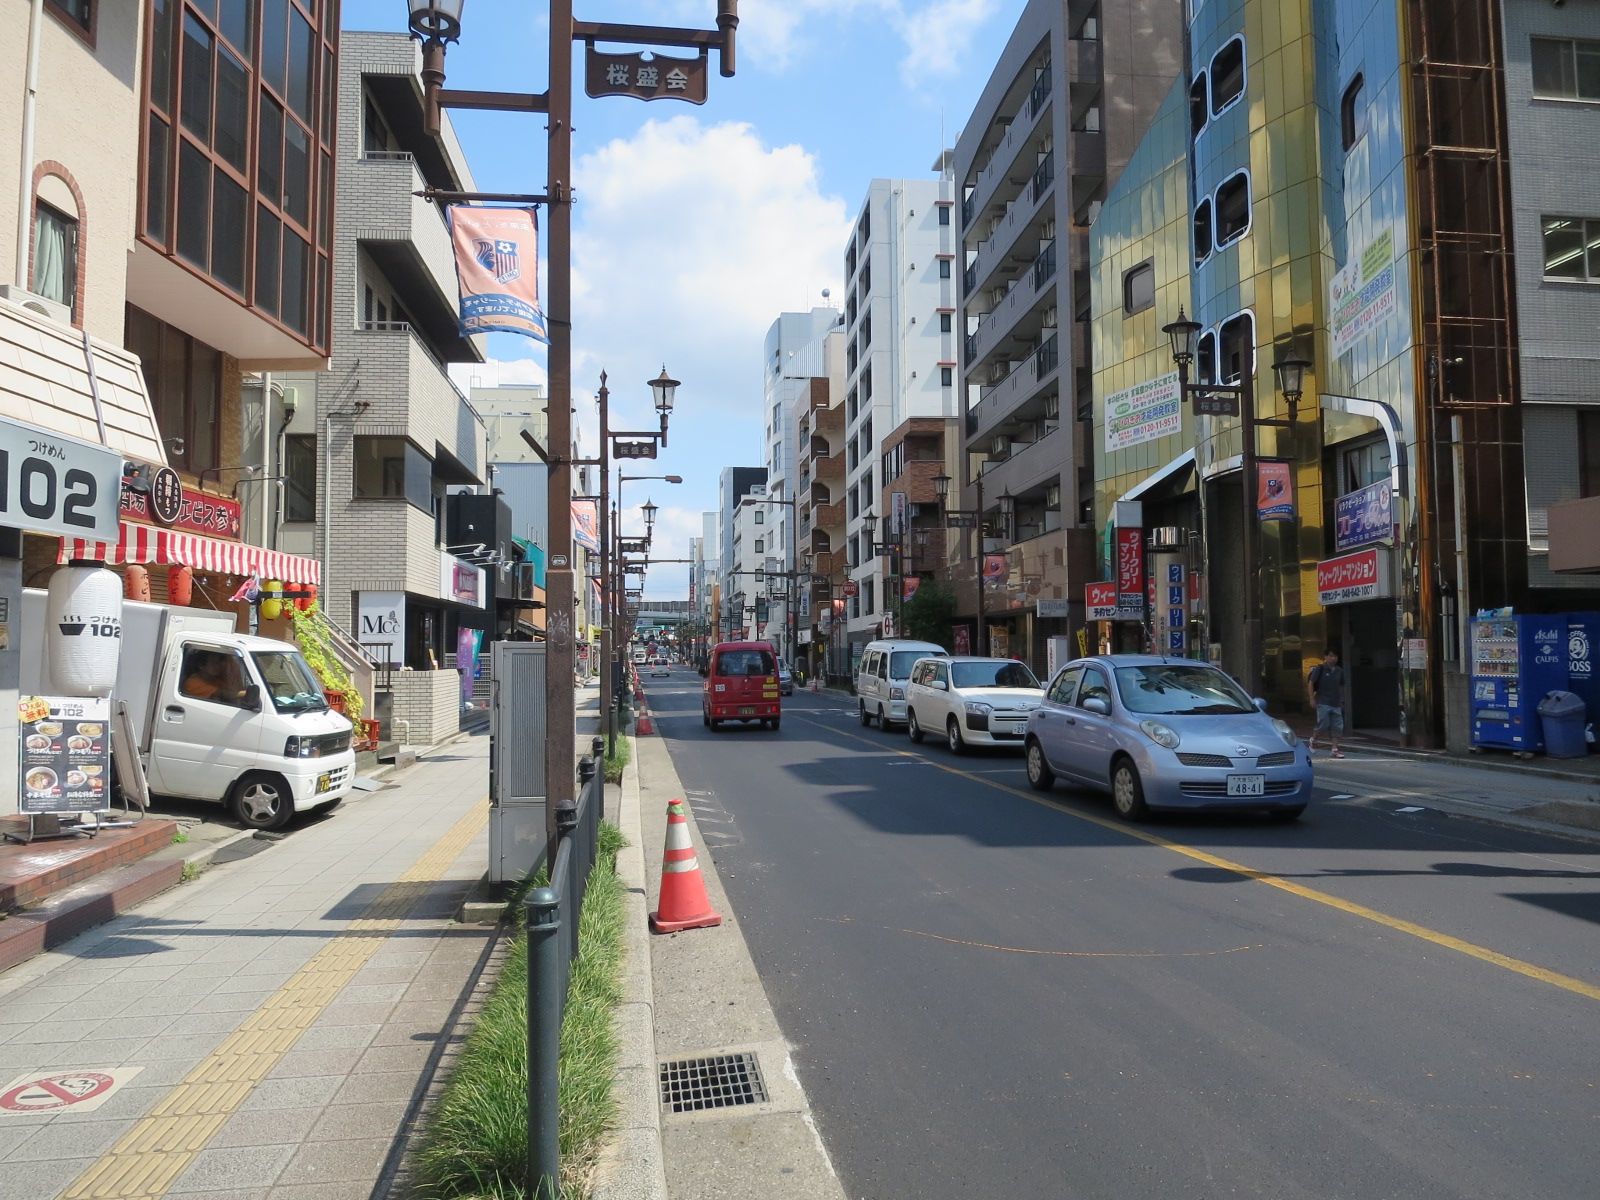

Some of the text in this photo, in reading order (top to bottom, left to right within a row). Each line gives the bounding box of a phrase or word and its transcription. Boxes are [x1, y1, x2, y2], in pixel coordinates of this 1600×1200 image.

[606, 64, 688, 90] 桜盛会
[1140, 416, 1178, 434] 0120-11-9511
[28, 439, 66, 460] つけめん
[0, 448, 97, 529] 102
[1120, 542, 1130, 590] マンション
[1130, 531, 1140, 584] ウィークリー
[1318, 559, 1375, 587] ウィークリーマンション
[1342, 585, 1374, 598] 048-642-1007
[1534, 629, 1558, 640] Asahi
[1535, 655, 1559, 664] CALPIS
[63, 708, 84, 717] 102
[1236, 783, 1261, 794] 48-41
